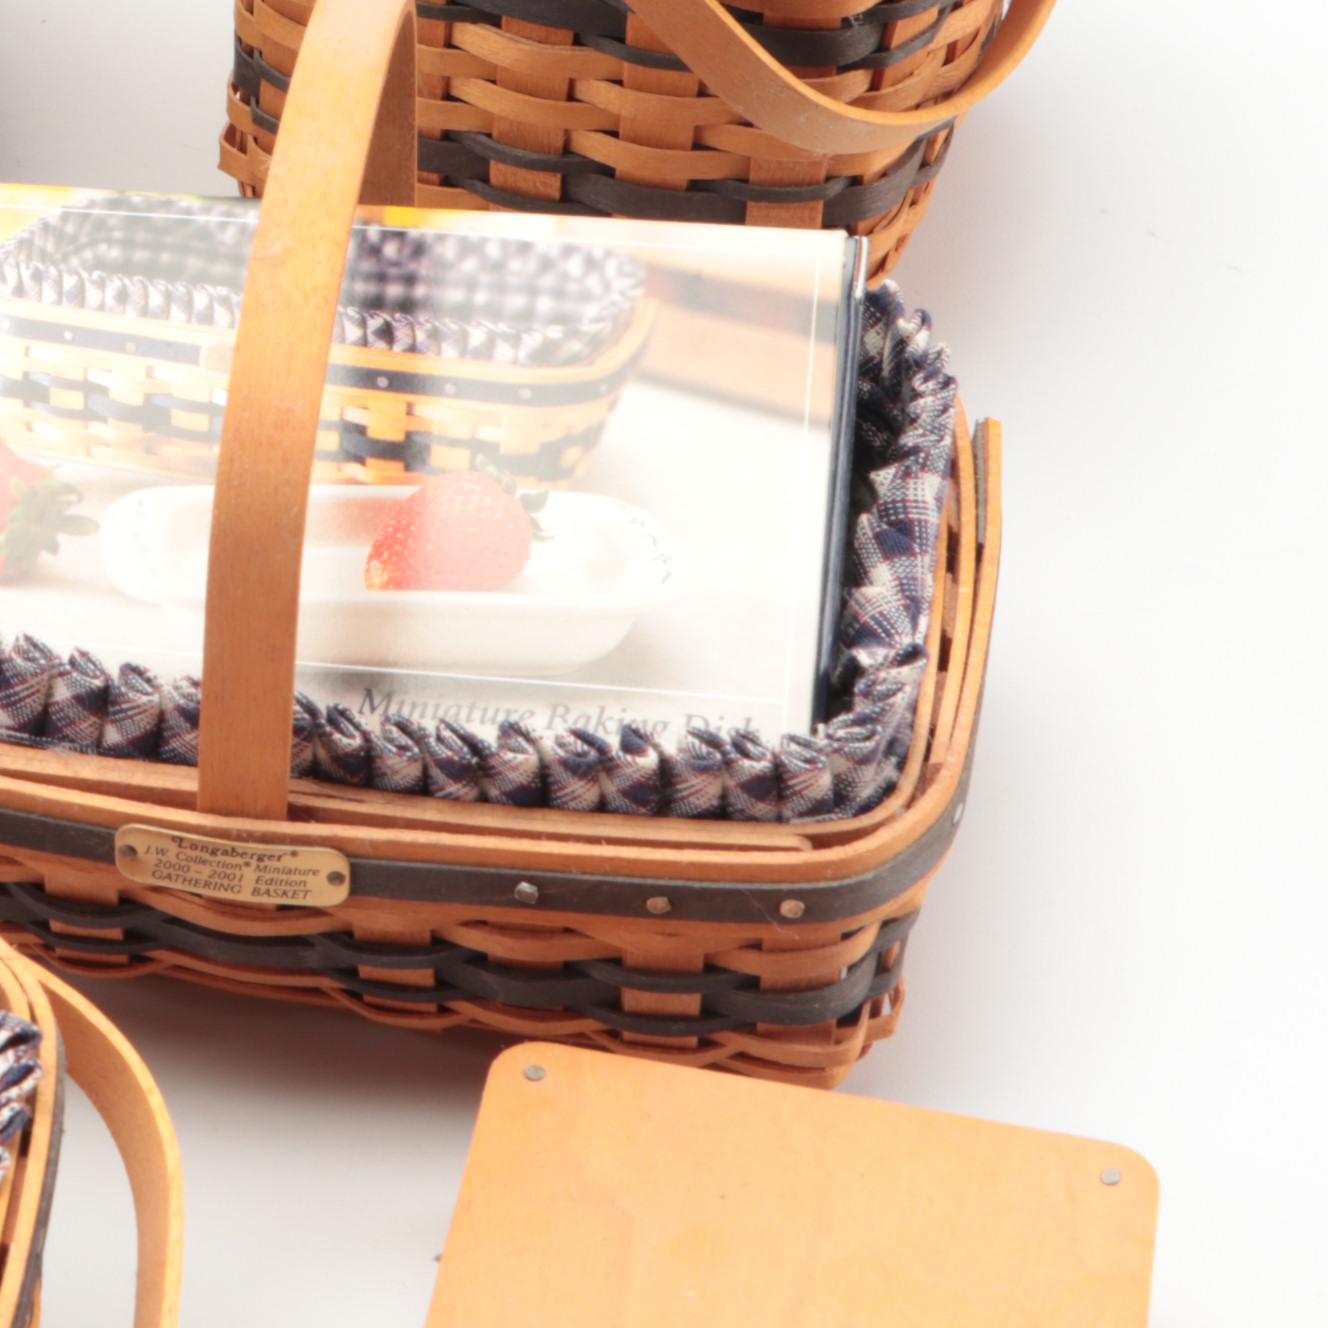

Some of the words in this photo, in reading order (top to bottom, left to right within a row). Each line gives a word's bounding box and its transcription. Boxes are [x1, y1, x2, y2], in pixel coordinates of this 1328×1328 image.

[358, 687, 535, 726] Miniature
[144, 845, 170, 858] J.W.
[254, 863, 320, 877] Miniature
[154, 858, 191, 873] 2000
[208, 867, 244, 883] 2001
[255, 875, 308, 888] Edition
[151, 870, 242, 895] GATHERING
[251, 887, 312, 901] BASKET
